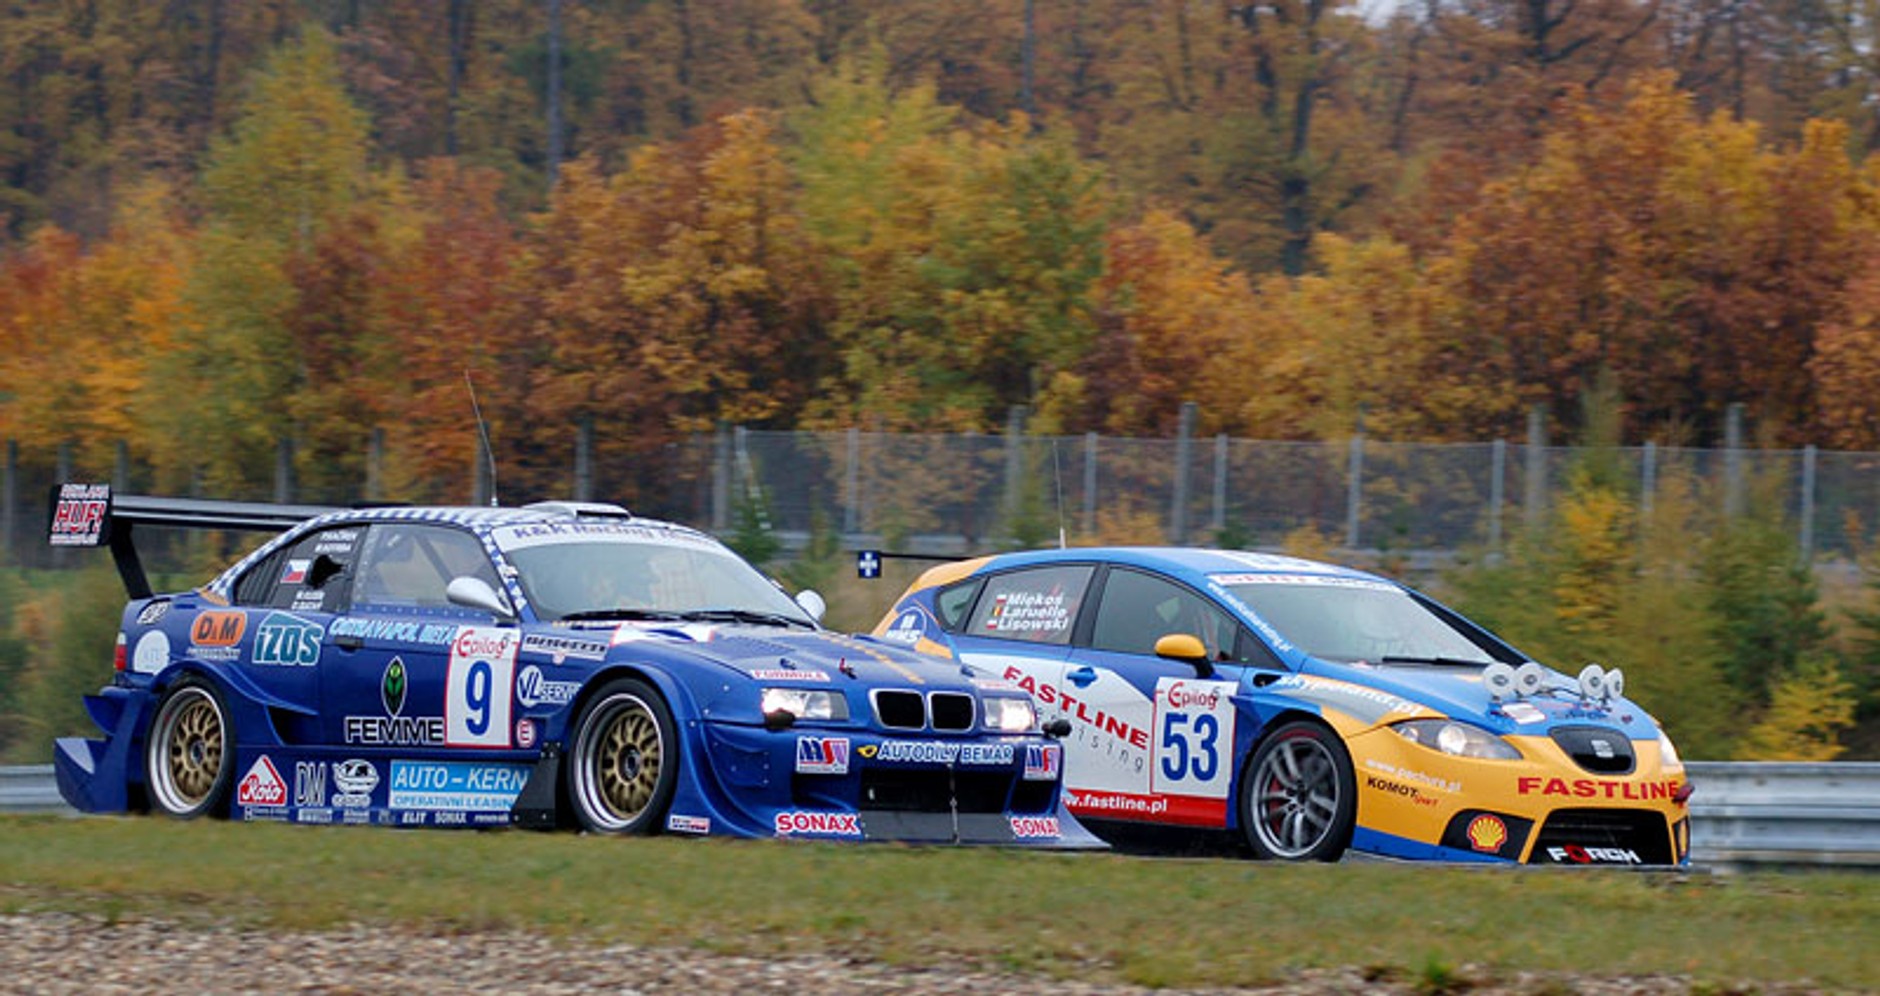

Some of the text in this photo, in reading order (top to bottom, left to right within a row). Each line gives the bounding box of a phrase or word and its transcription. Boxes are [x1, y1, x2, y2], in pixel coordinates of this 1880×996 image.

[997, 618, 1069, 631] Lisowski
[465, 660, 492, 735] 9
[1003, 665, 1149, 750] FASTLINE
[1168, 682, 1218, 710] Epilog
[344, 716, 444, 744] FEMME
[1161, 711, 1219, 781] 53
[395, 766, 449, 789] AUTO
[467, 768, 529, 791] KERN
[1517, 777, 1680, 800] FASTLINE
[775, 812, 859, 834] SONAX
[1011, 818, 1060, 838] SONA
